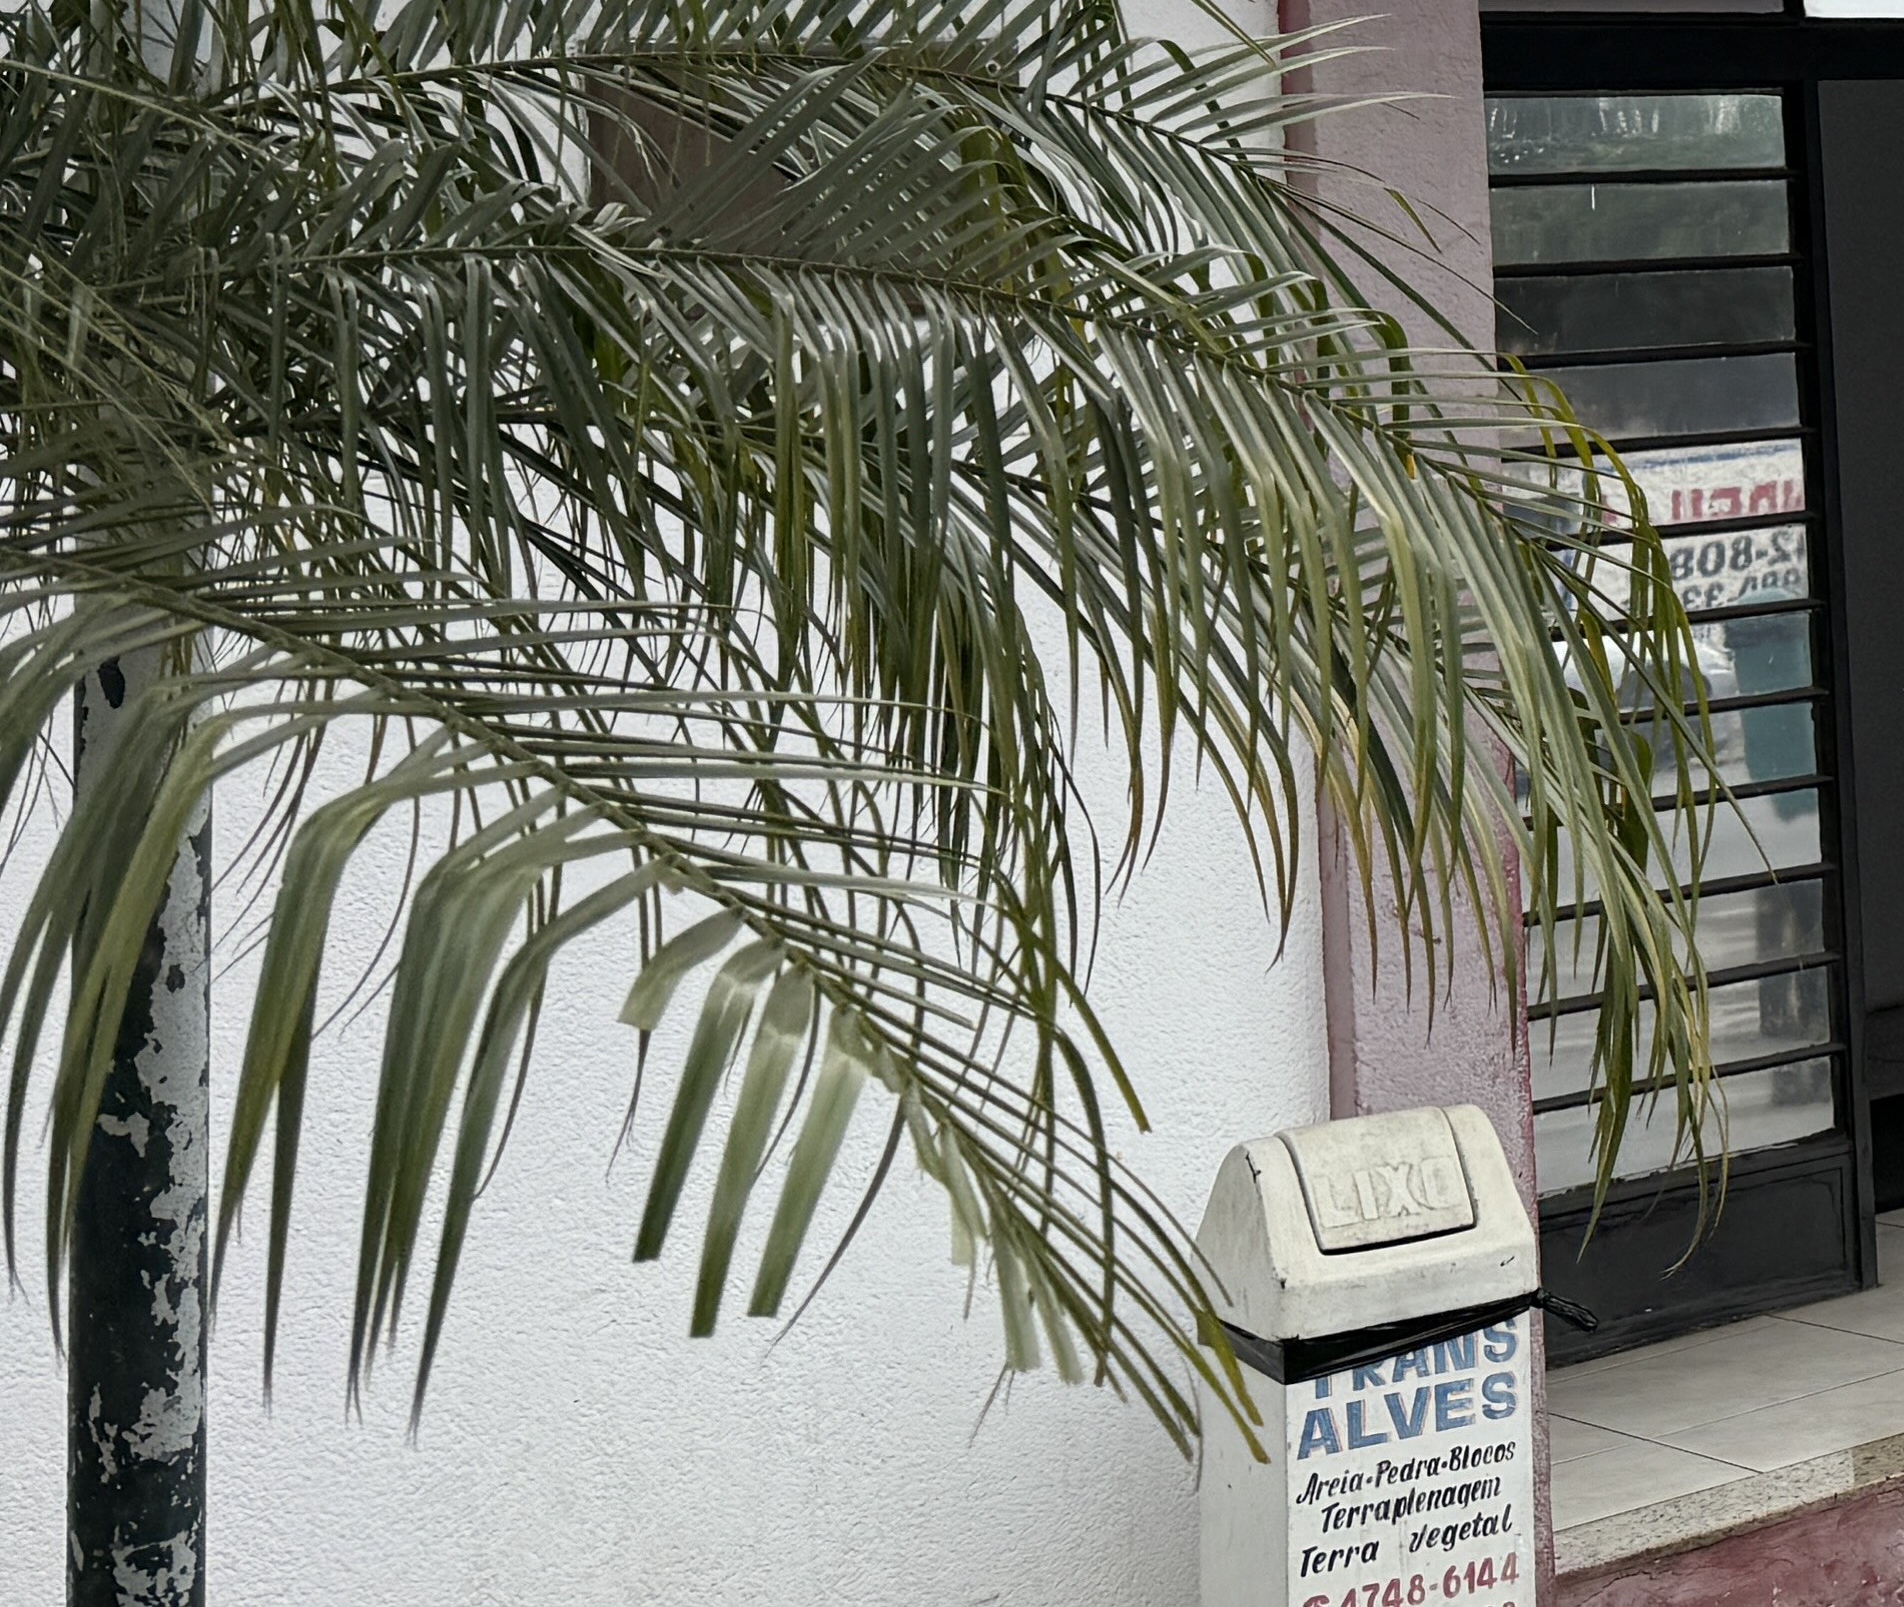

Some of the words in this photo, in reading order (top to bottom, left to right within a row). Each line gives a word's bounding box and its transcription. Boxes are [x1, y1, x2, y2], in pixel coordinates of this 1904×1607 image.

[1312, 1155, 1464, 1229] LIXO
[1296, 1370, 1518, 1460] ALVES
[1321, 1476, 1501, 1534] Terraplenagem
[1300, 1540, 1380, 1578] Terra
